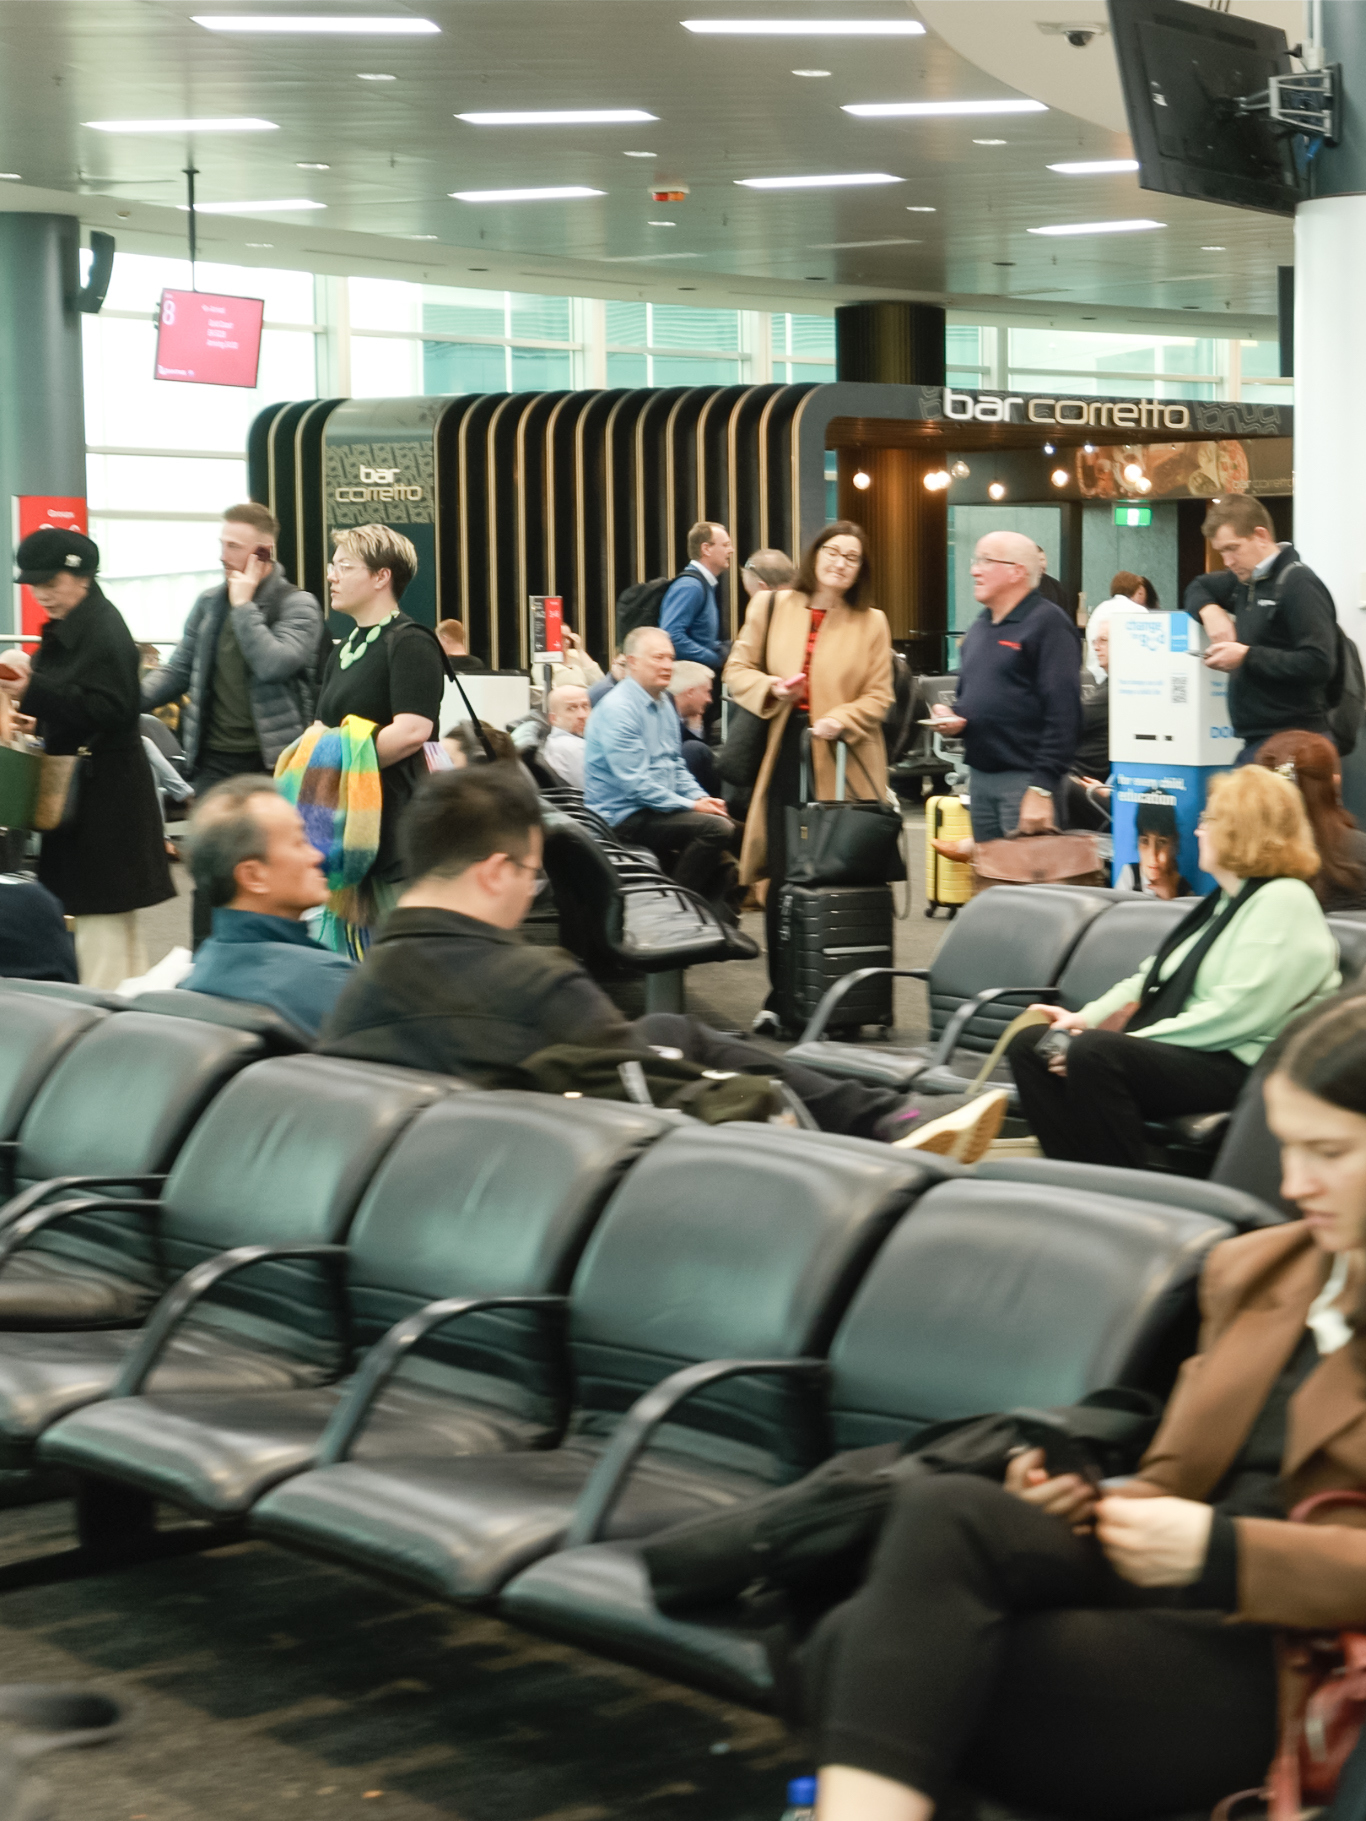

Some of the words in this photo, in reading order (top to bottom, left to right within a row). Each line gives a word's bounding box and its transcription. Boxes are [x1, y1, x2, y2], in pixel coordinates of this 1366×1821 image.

[162, 299, 176, 326] 8
[942, 386, 1024, 422] bar
[1028, 397, 1191, 429] corretto
[360, 464, 402, 484] bar
[335, 482, 423, 503] corretto
